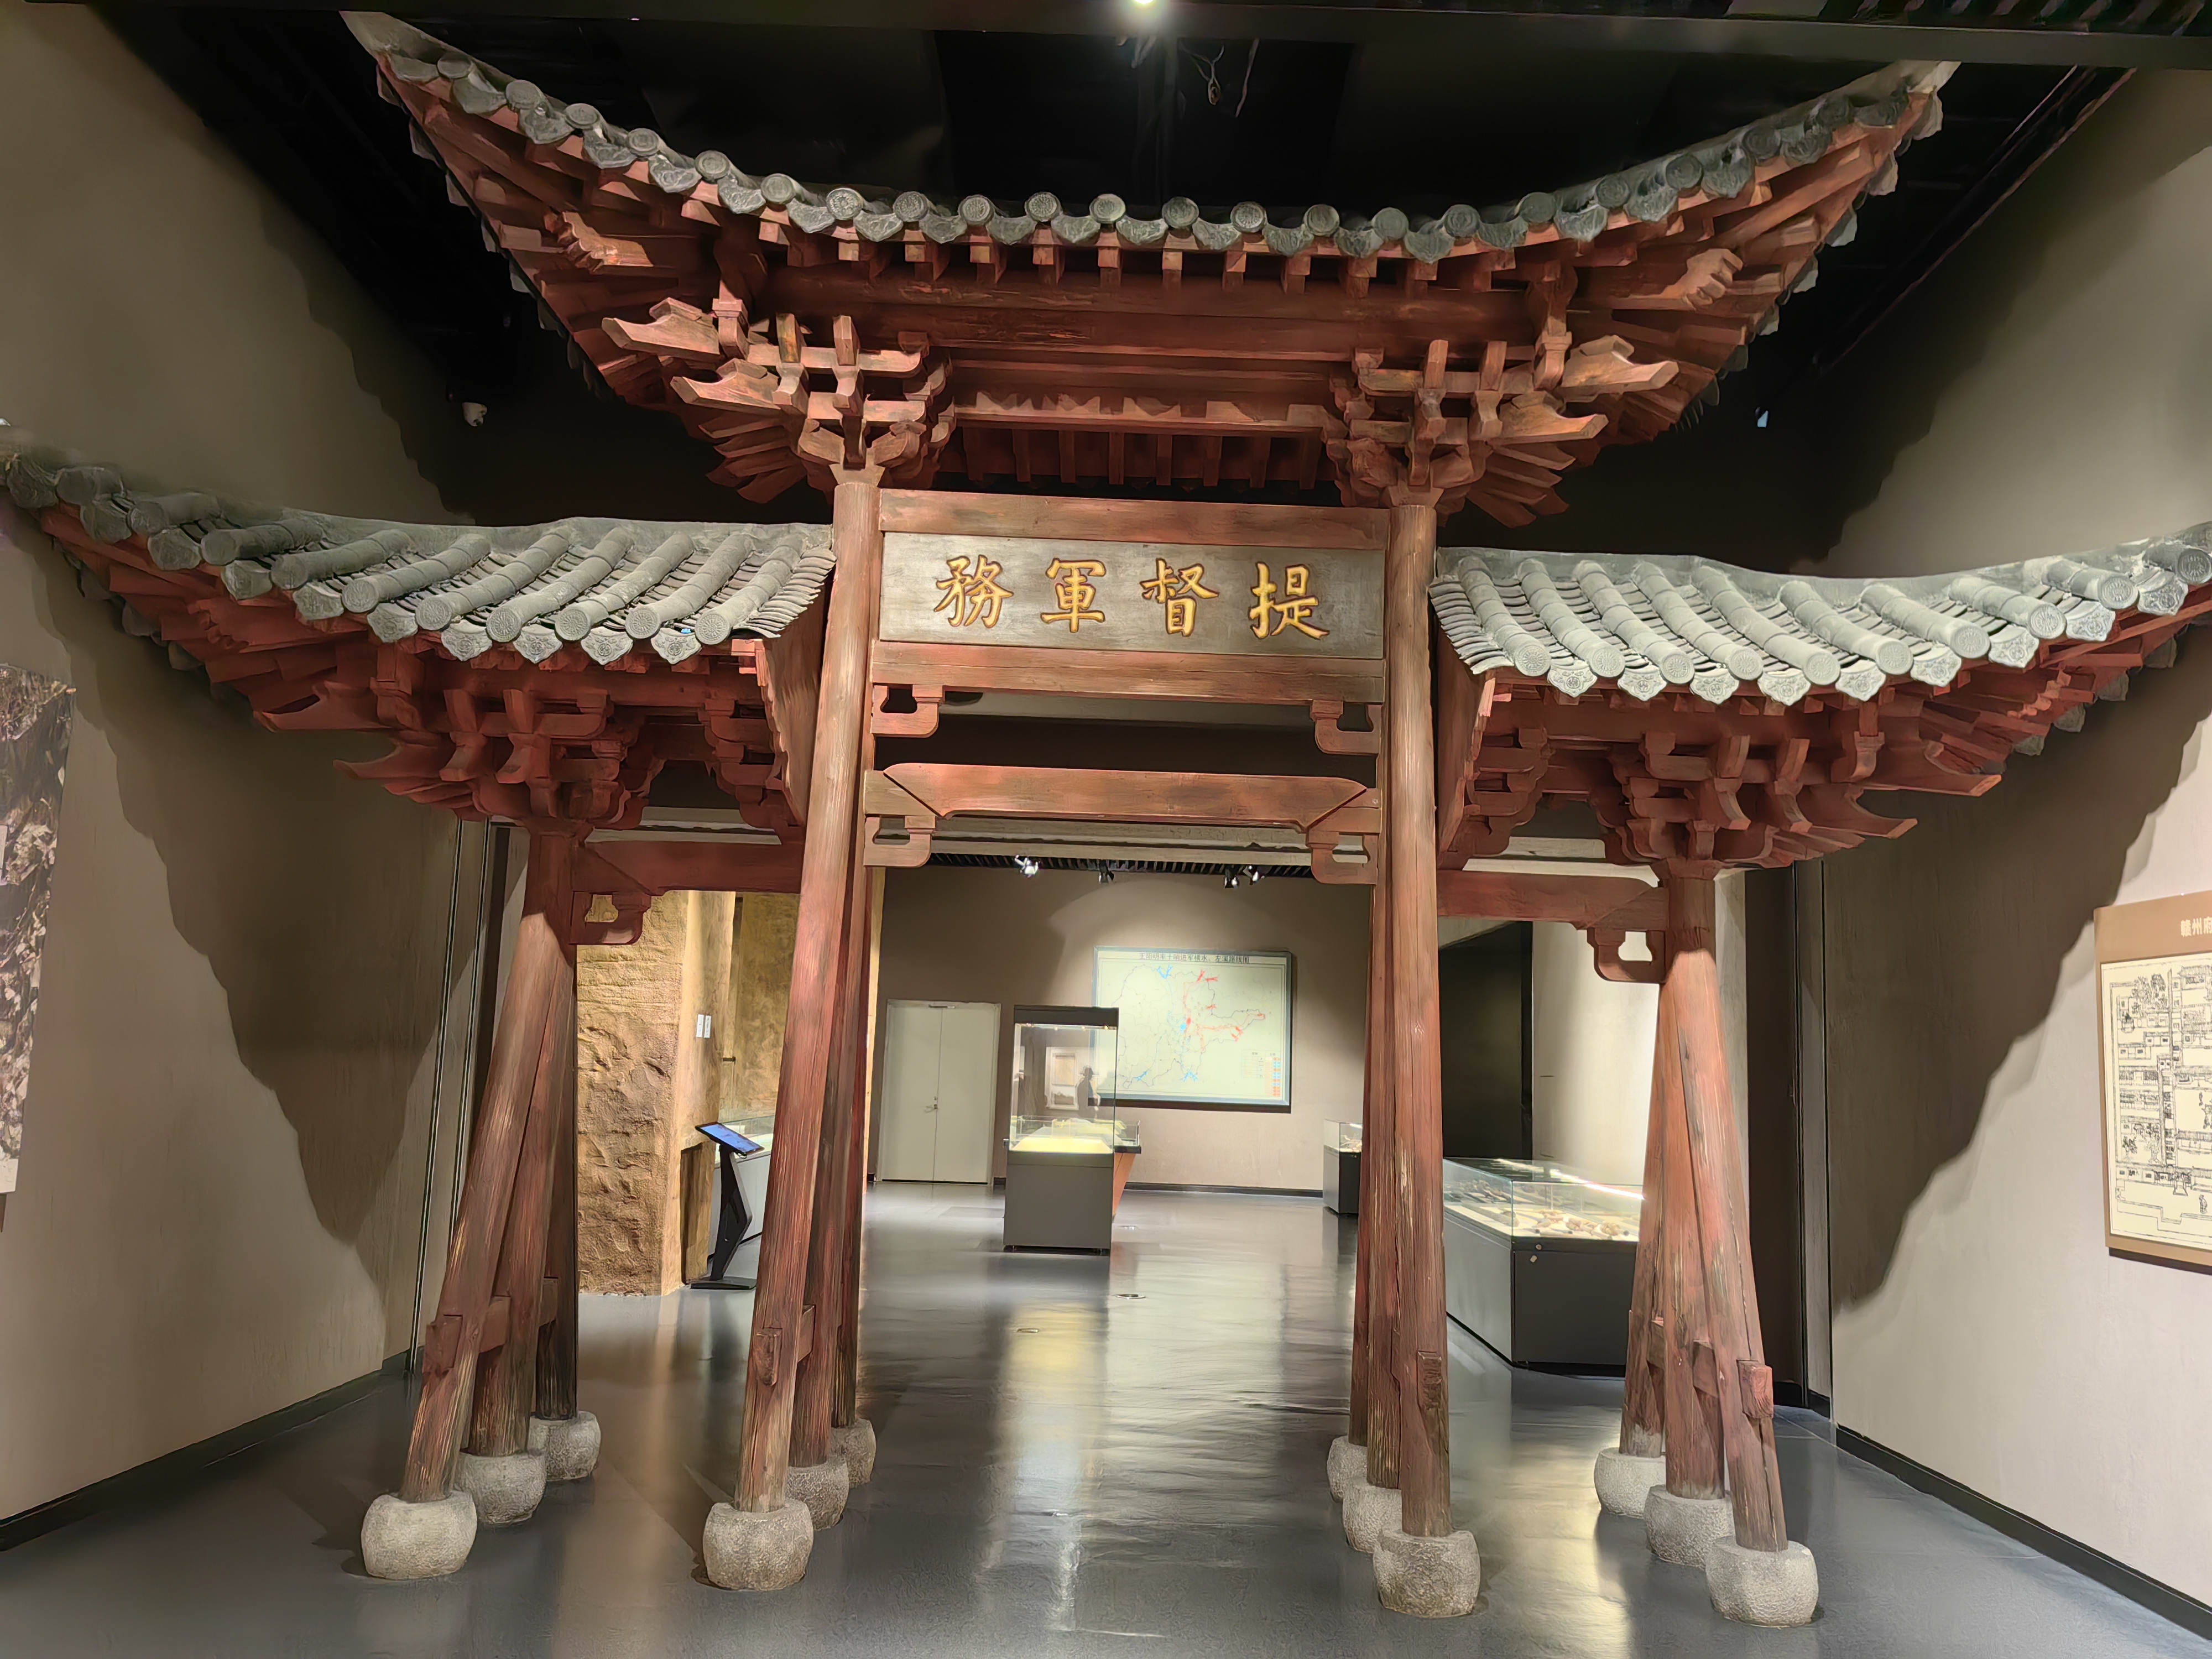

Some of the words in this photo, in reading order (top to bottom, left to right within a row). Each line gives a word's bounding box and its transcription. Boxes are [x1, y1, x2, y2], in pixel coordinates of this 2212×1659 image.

[935, 555, 1330, 640] 提督軍務
[2180, 916, 2212, 937] 赣州府
